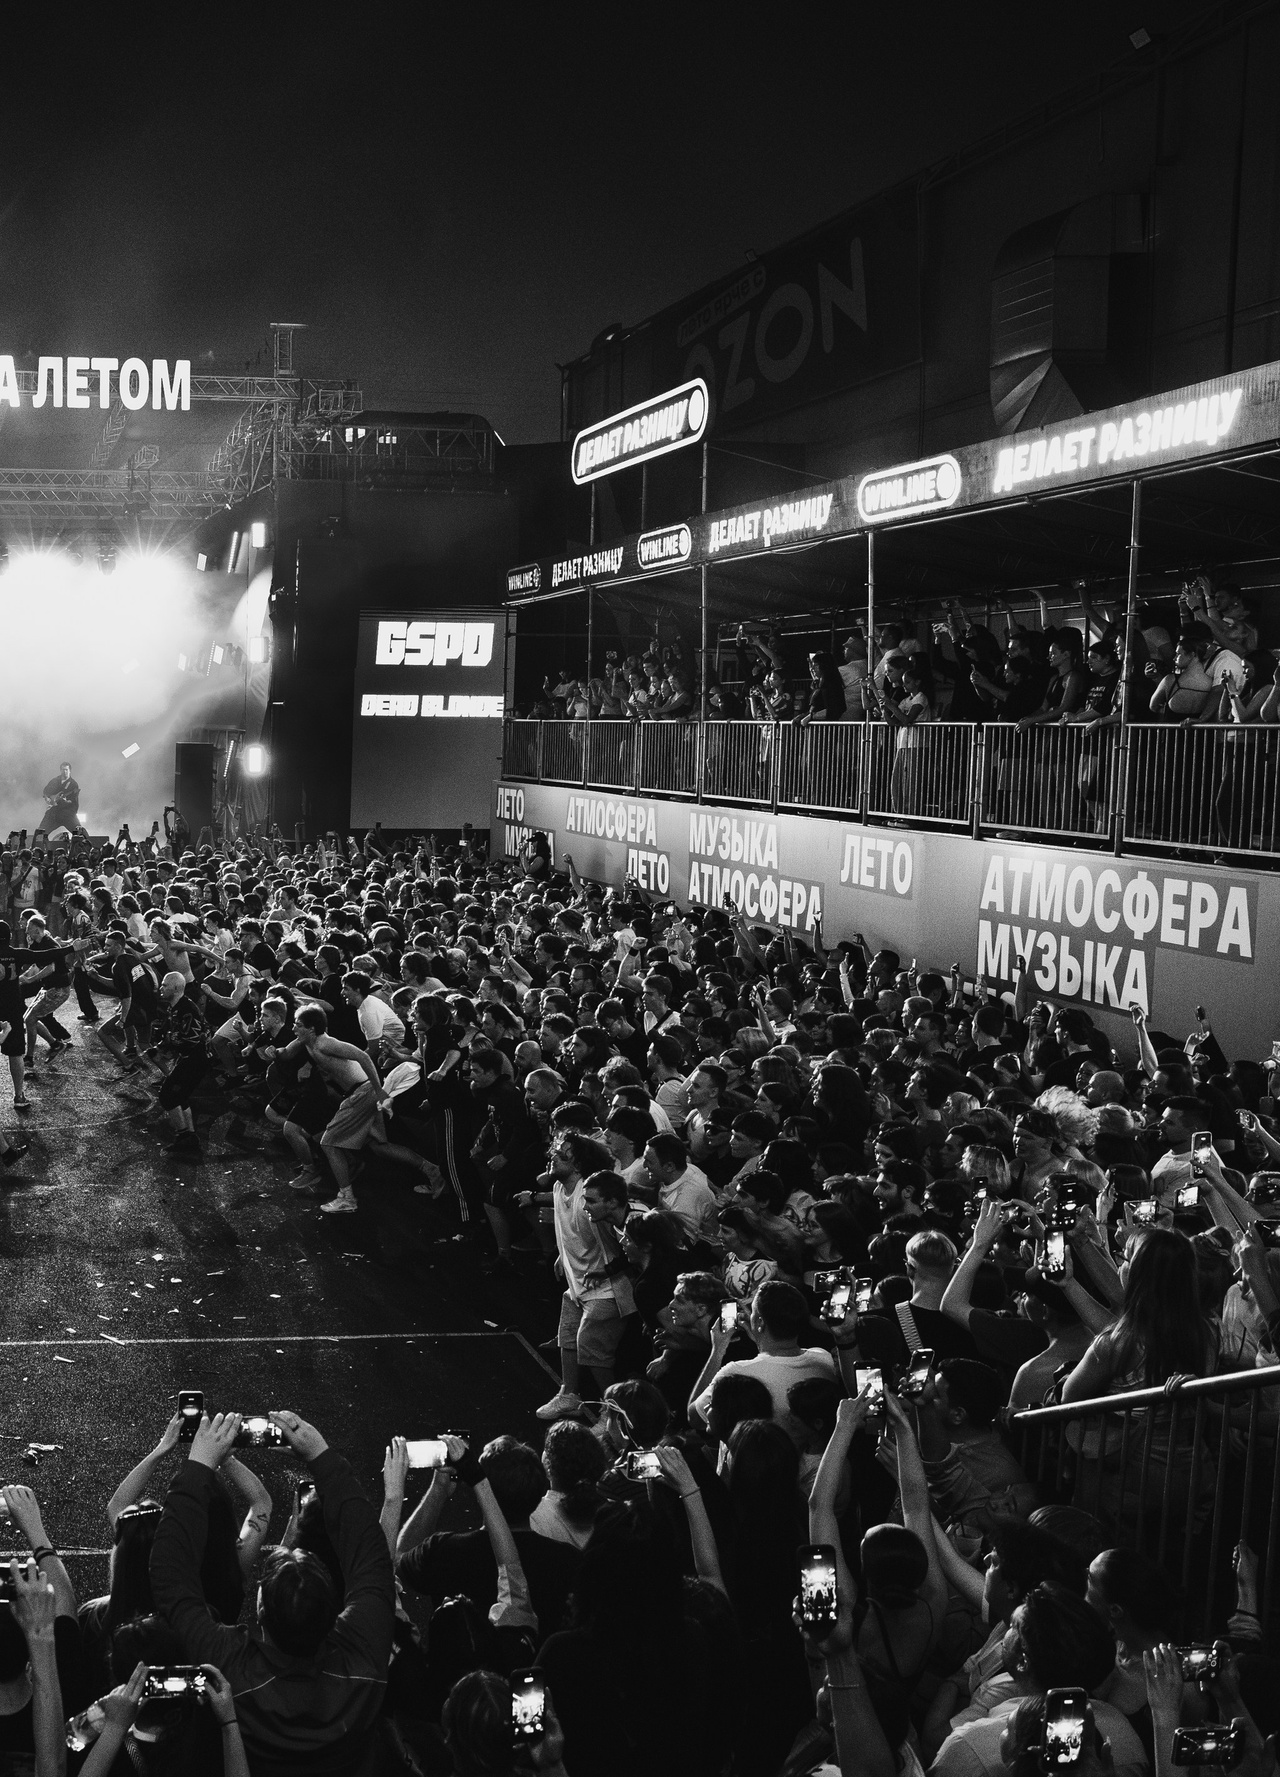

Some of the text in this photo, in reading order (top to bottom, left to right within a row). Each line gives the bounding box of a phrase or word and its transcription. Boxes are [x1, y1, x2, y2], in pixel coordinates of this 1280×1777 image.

[31, 356, 191, 411] ЛЕТОМ
[576, 398, 689, 478] ДЕЛАЕТ РАЗНИЦУ
[993, 388, 1243, 494] ДЕЛАЕТ РАЗНИЦУ
[864, 469, 937, 512] WINLINE
[640, 537, 679, 562] WINLINE
[708, 493, 833, 553] ДЕЛАЕТ РАЗНИЦУ
[507, 570, 534, 591] WINLINE
[551, 546, 624, 587] ДЕЛАЕТ РАЗНИЦУ
[375, 621, 495, 667] GSPD
[361, 694, 505, 718] DEAD BLONDE
[496, 787, 525, 822] ЛЕТО
[566, 796, 657, 847] АТМОСФЕРА
[688, 811, 778, 870] МУЗЫКА
[840, 833, 913, 895] ЛЕТО
[627, 848, 669, 894] ЛЕТО
[688, 860, 823, 933] АТМОСФЕРА
[980, 854, 1253, 958] АТМОСФЕРА
[977, 919, 1150, 1016] МУЗЫКА
